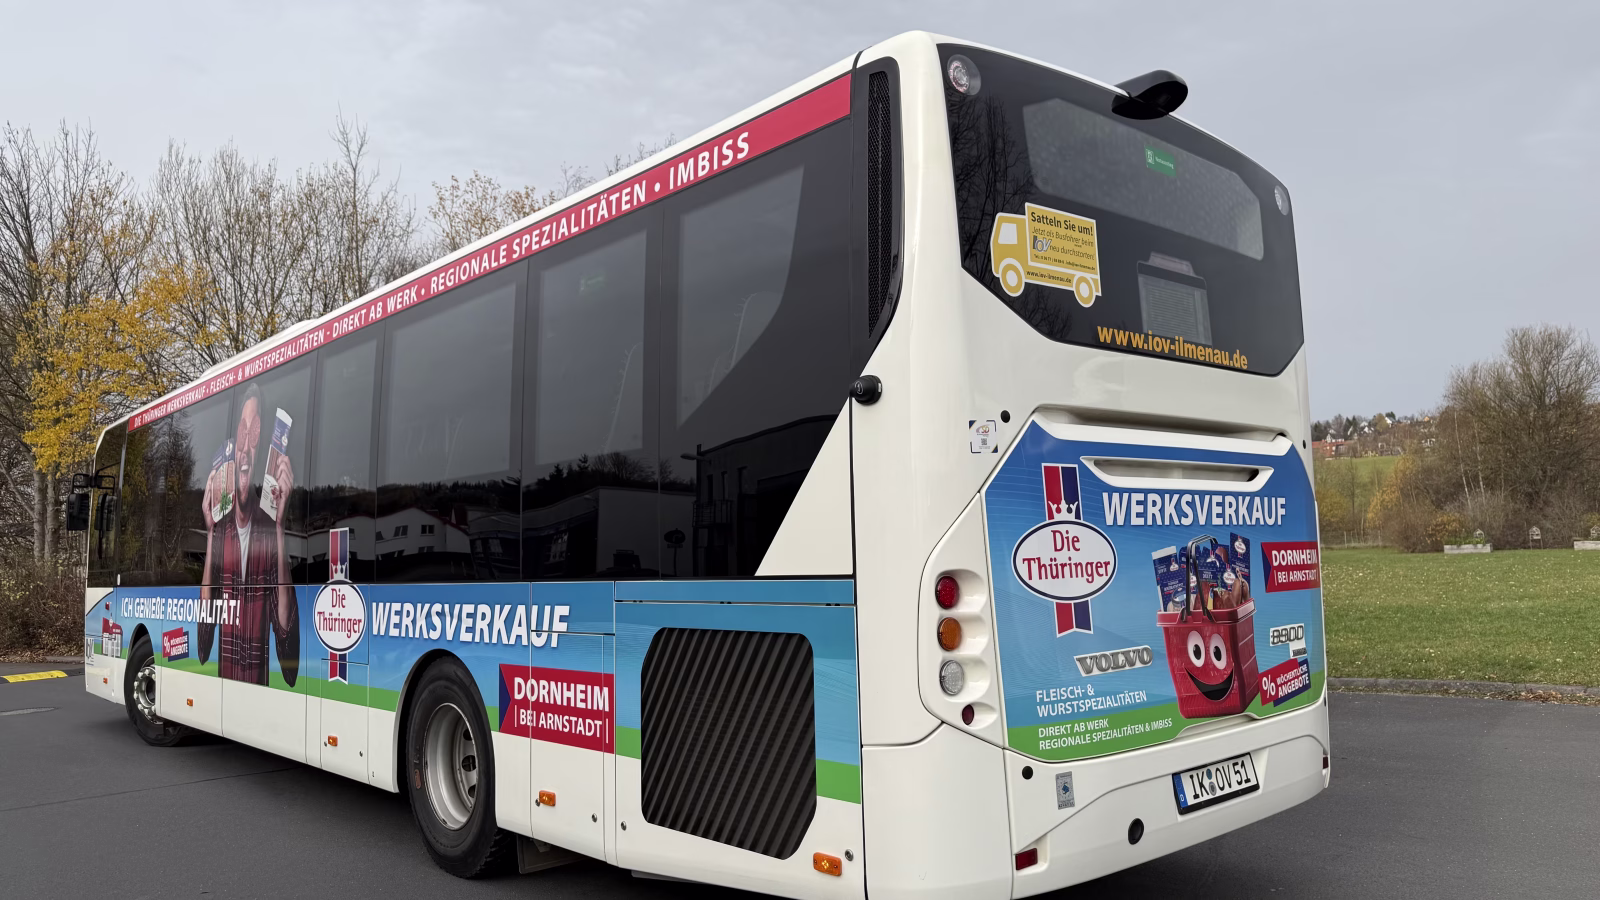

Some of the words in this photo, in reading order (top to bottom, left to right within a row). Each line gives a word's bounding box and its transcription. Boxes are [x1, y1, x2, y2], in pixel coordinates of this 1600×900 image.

[1030, 212, 1062, 228] Satteln
[1064, 220, 1076, 232] Sie
[1078, 225, 1094, 236] um!
[1032, 226, 1046, 236] Jetzt
[1056, 232, 1080, 244] Busfahrer
[1050, 244, 1060, 252] neu
[166, 386, 206, 412] WERKSVERKAUF
[244, 328, 325, 378] WURSTSPEZIALITÄTEN
[332, 309, 366, 338] DIREKT
[368, 302, 382, 322] AB
[387, 285, 418, 314] WERK
[430, 244, 508, 294] REGIONALE
[512, 180, 647, 260] SPEZIALITÄTEN
[669, 132, 750, 190] IMBISS
[1026, 270, 1072, 284] www.iov-ilmenau.de
[1097, 326, 1248, 370] www.iov-ilmenau.de
[1102, 492, 1286, 526] WERKSVERKAUF
[1050, 530, 1080, 552] Die
[1022, 556, 1110, 584] Thüringer
[1272, 548, 1318, 566] DORNHEIM
[1278, 571, 1288, 583] BEI
[121, 598, 134, 618] ICH
[166, 592, 240, 626] REGIONALITÄT!
[331, 588, 346, 608] Die
[317, 611, 362, 638] Thüringer
[372, 602, 570, 648] WERKSVERKAUF
[1076, 646, 1153, 675] VOLVO
[514, 676, 610, 712] DORNHEIM
[1036, 686, 1086, 702] FLEISCH-
[1087, 684, 1095, 696] &
[1278, 673, 1310, 698] ANGEBOTE
[1036, 690, 1147, 718] WURSTSPEZIALITÄTEN
[520, 709, 536, 726] BEI
[538, 712, 602, 738] ARNSTADT
[1038, 724, 1072, 738] DIREKT
[1074, 722, 1086, 732] AB
[1086, 718, 1109, 731] WERK
[1040, 734, 1090, 750] REGIONALE
[1092, 723, 1144, 742] SPEZIALITÄTEN
[1144, 722, 1150, 732] &
[1151, 718, 1172, 731] IMBISS
[1189, 770, 1210, 800] IK
[1214, 764, 1232, 792] OV
[1232, 760, 1252, 786] 51
